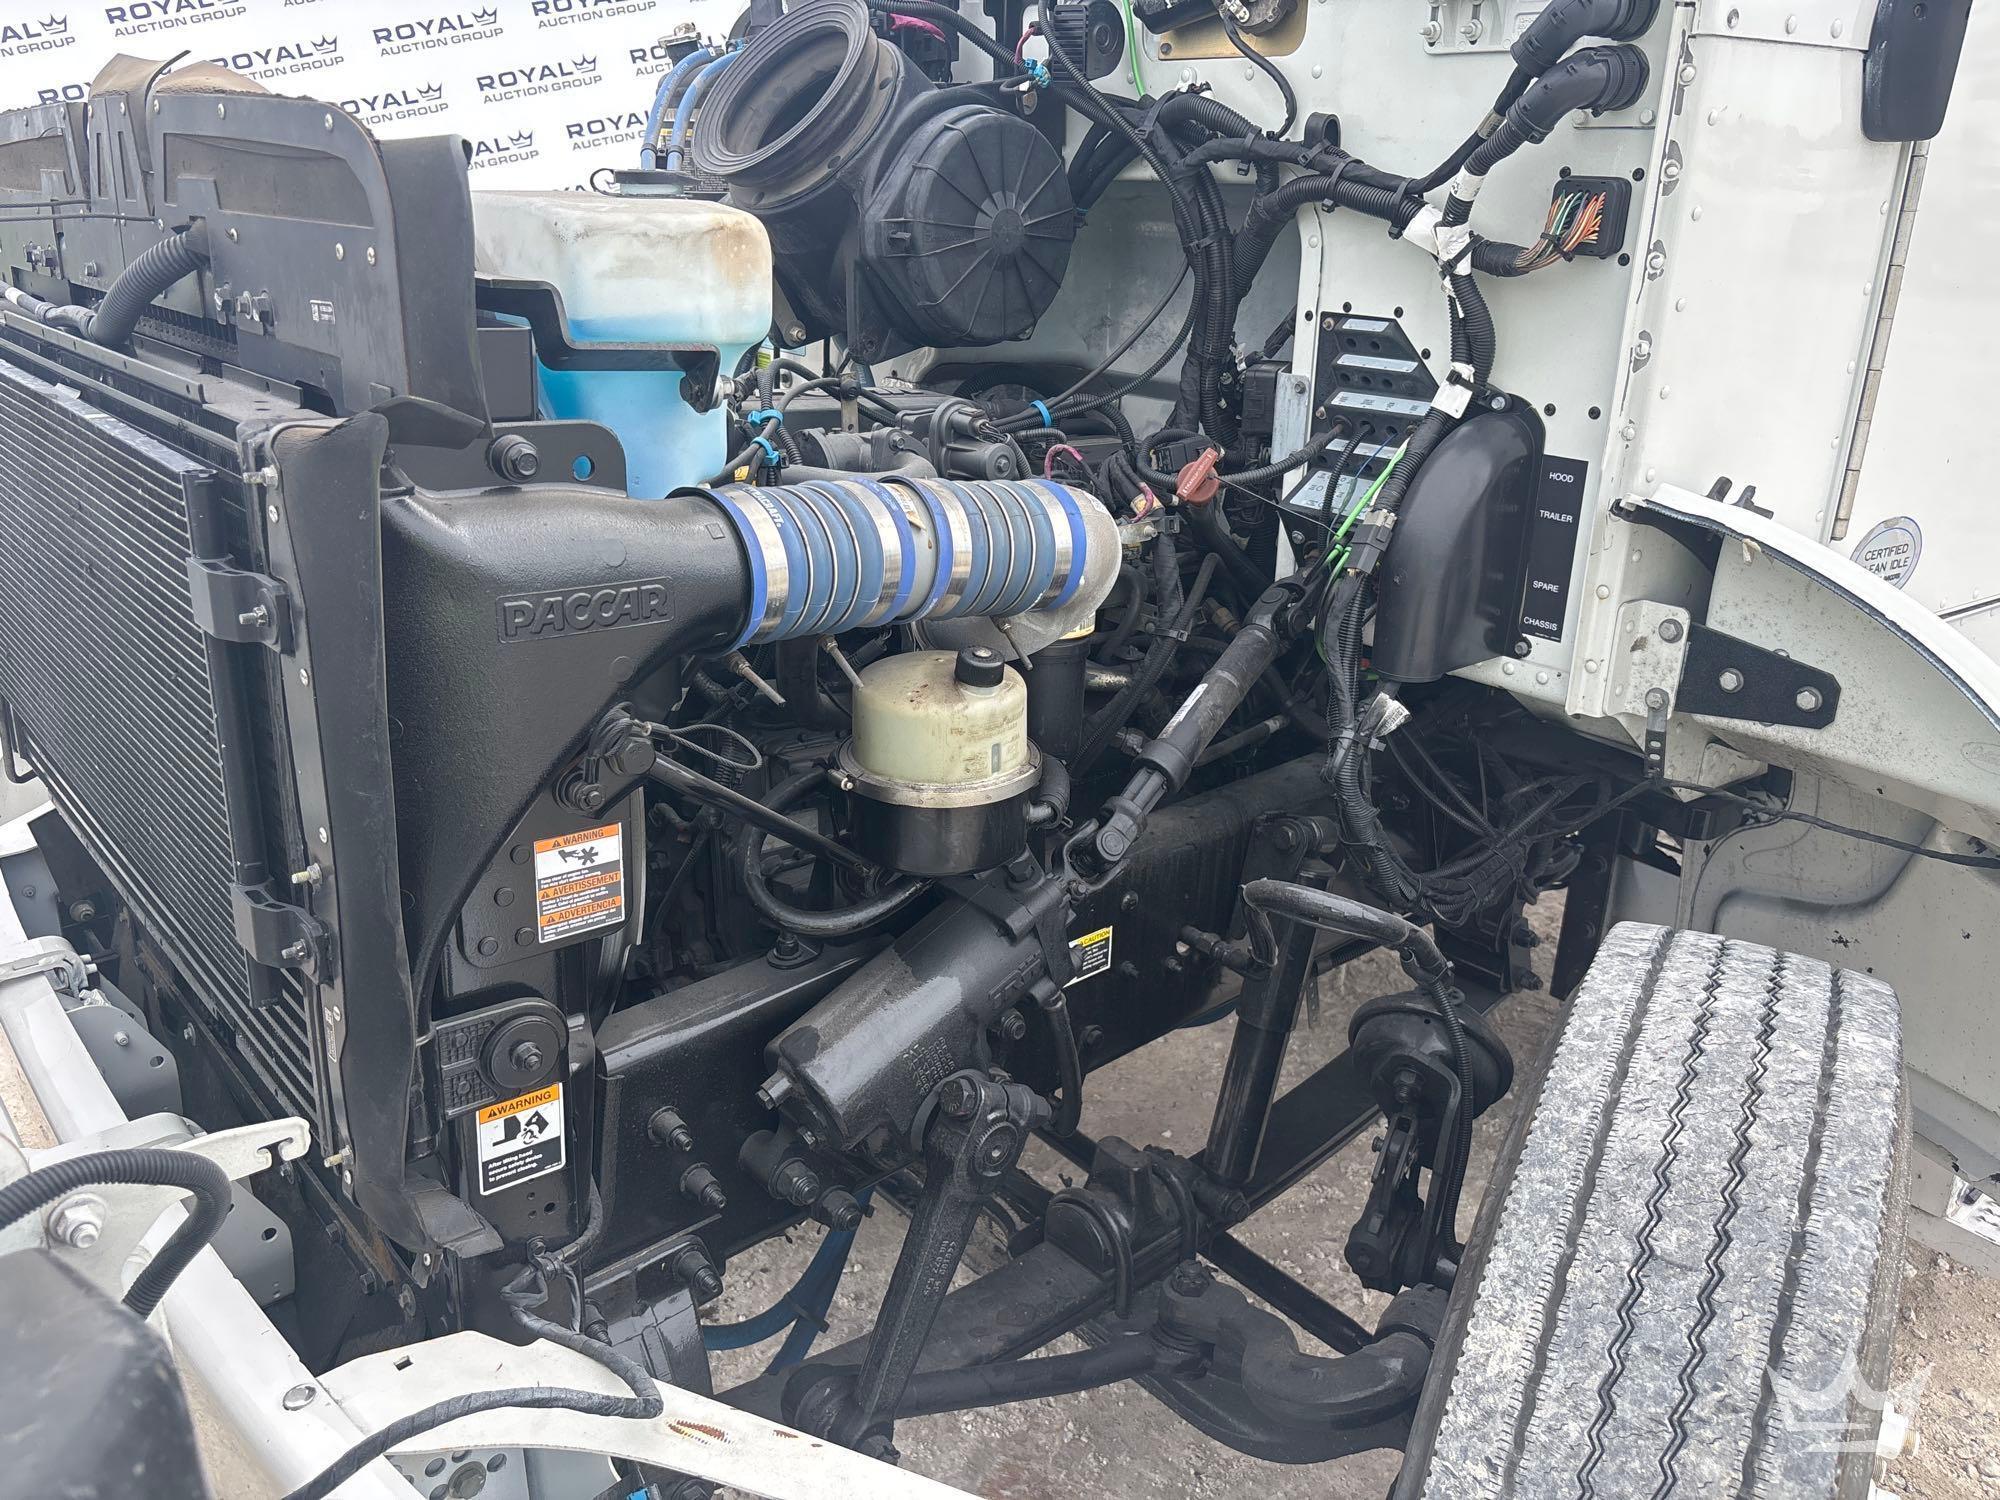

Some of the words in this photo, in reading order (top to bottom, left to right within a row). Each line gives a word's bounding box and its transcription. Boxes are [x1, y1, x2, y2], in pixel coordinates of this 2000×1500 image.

[114, 17, 188, 37] AUCTION
[190, 6, 247, 24] GROUP
[538, 10, 603, 29] AUCTION
[606, 1, 656, 17] GROUP
[373, 14, 474, 45] ROYAL
[16, 36, 75, 54] GROUP
[380, 36, 448, 57] AUCTION
[450, 27, 504, 45] GROUP
[249, 66, 287, 80] TION
[289, 56, 345, 73] GROUP
[476, 62, 574, 91] ROYAL
[635, 62, 672, 77] AUCT
[483, 84, 549, 104] AUCTION
[551, 75, 602, 92] GROUP
[340, 90, 419, 114] OYAL
[396, 102, 449, 120] GROUP
[572, 131, 635, 151] AUCTION
[487, 149, 539, 167] GROUP
[1549, 472, 1574, 483] HOOD
[1539, 509, 1573, 523] TRAILER
[1864, 543, 1909, 561] CERTIFIED
[1890, 557, 1910, 570] IDLE
[1532, 580, 1559, 593] SPARE
[504, 585, 668, 638] PACCAR
[1523, 616, 1558, 631] CHASSIS
[562, 828, 605, 846] WARNING
[552, 872, 619, 897] AVERTISSEMENT
[558, 898, 617, 920] ADVERTENCIA
[497, 1090, 552, 1115] WARNING
